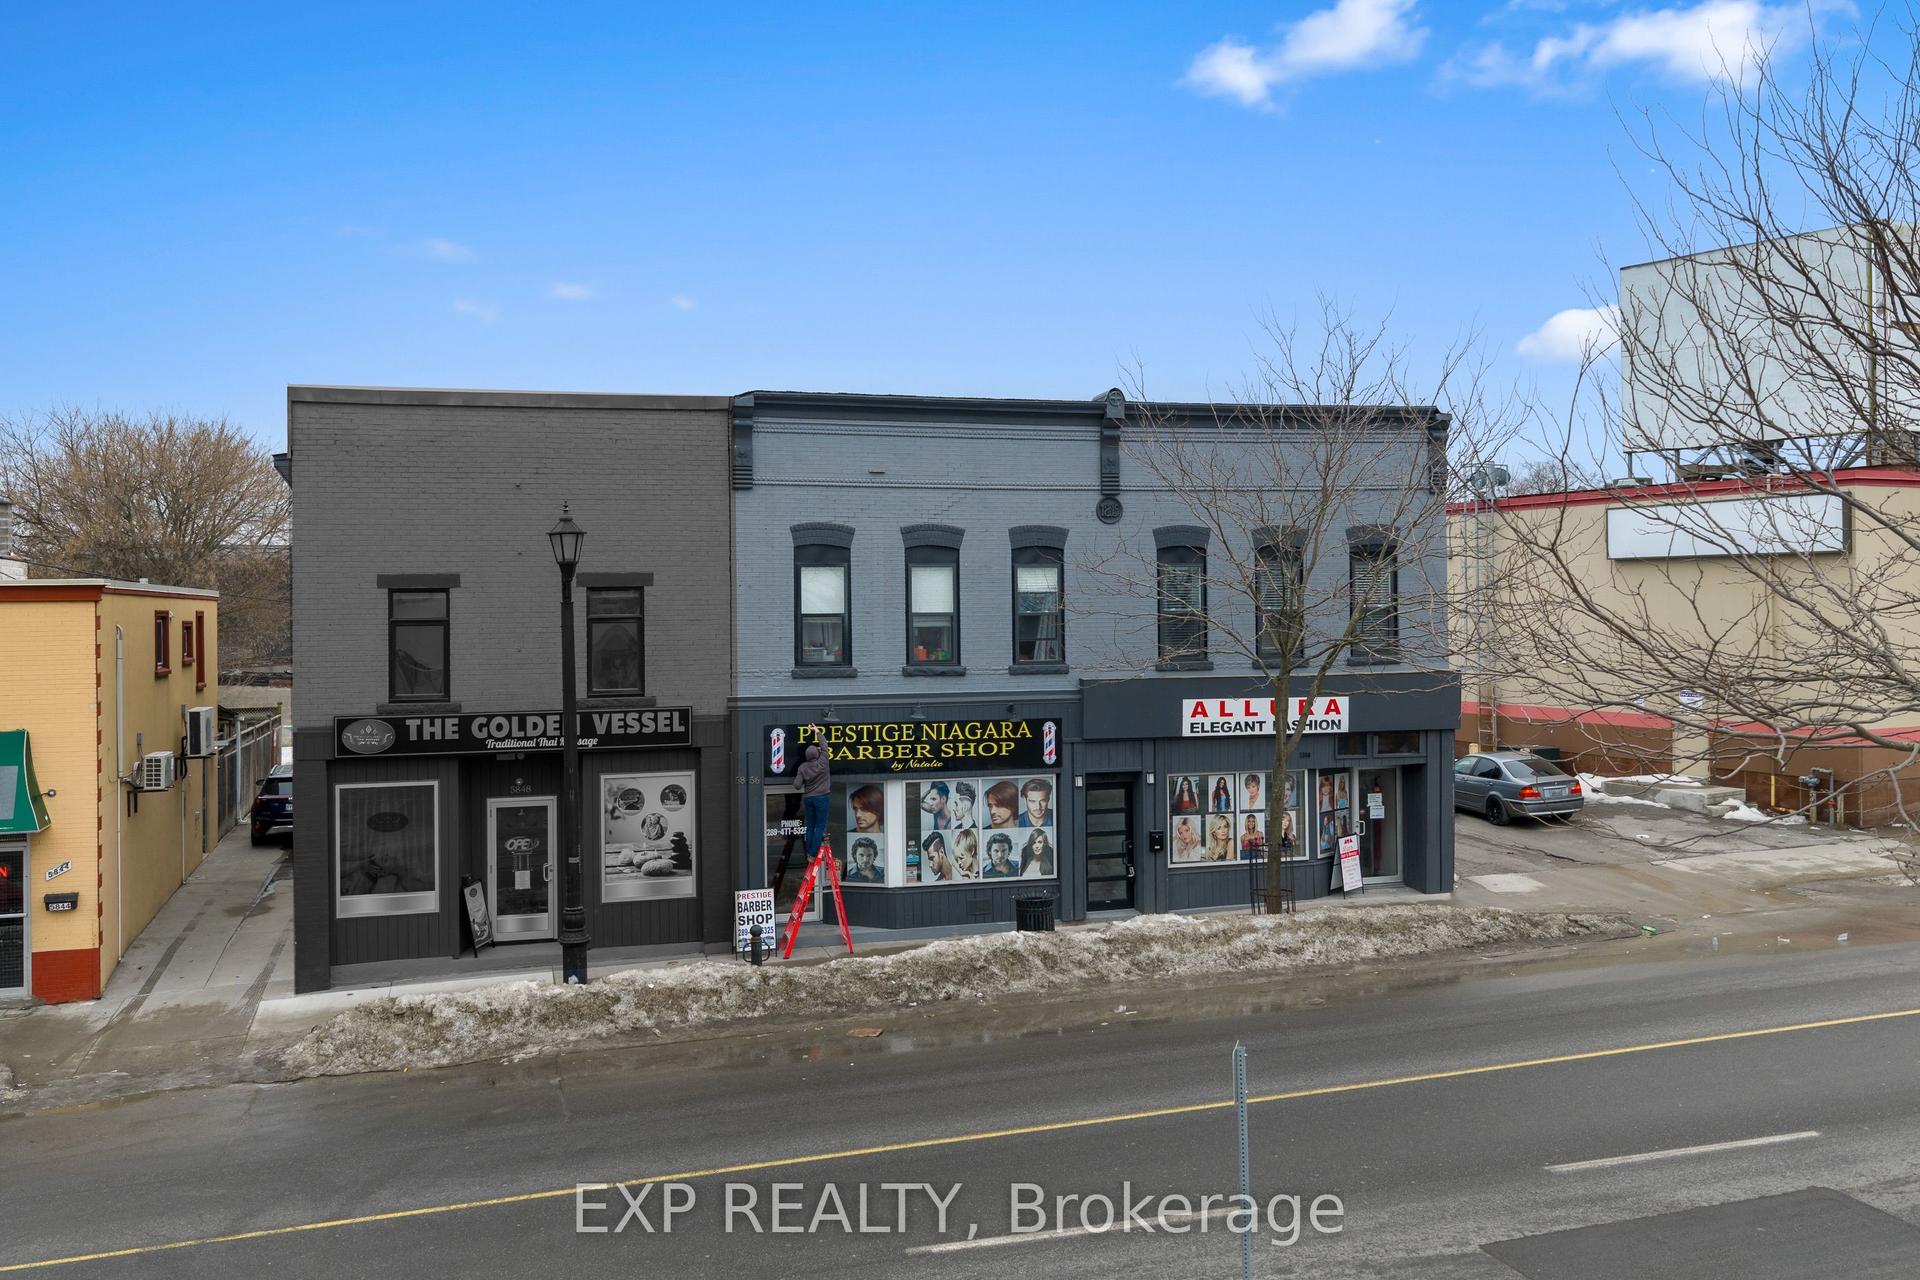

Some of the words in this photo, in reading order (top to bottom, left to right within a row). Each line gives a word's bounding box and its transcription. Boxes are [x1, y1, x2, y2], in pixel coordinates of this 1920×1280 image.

[405, 718, 459, 741] THE
[592, 711, 685, 735] VESSEL
[921, 721, 1033, 741] NIAGARA
[1190, 720, 1266, 734] ELEGANT
[486, 738, 536, 749] Traditional
[538, 737, 558, 747] Thai
[940, 741, 1016, 757] SHOP
[891, 760, 903, 772] by
[905, 760, 944, 769] Natalie
[781, 820, 803, 828] PHONE:
[737, 891, 772, 900] PRESTIGE
[738, 900, 772, 913] BARBER
[738, 914, 773, 926] SHOP
